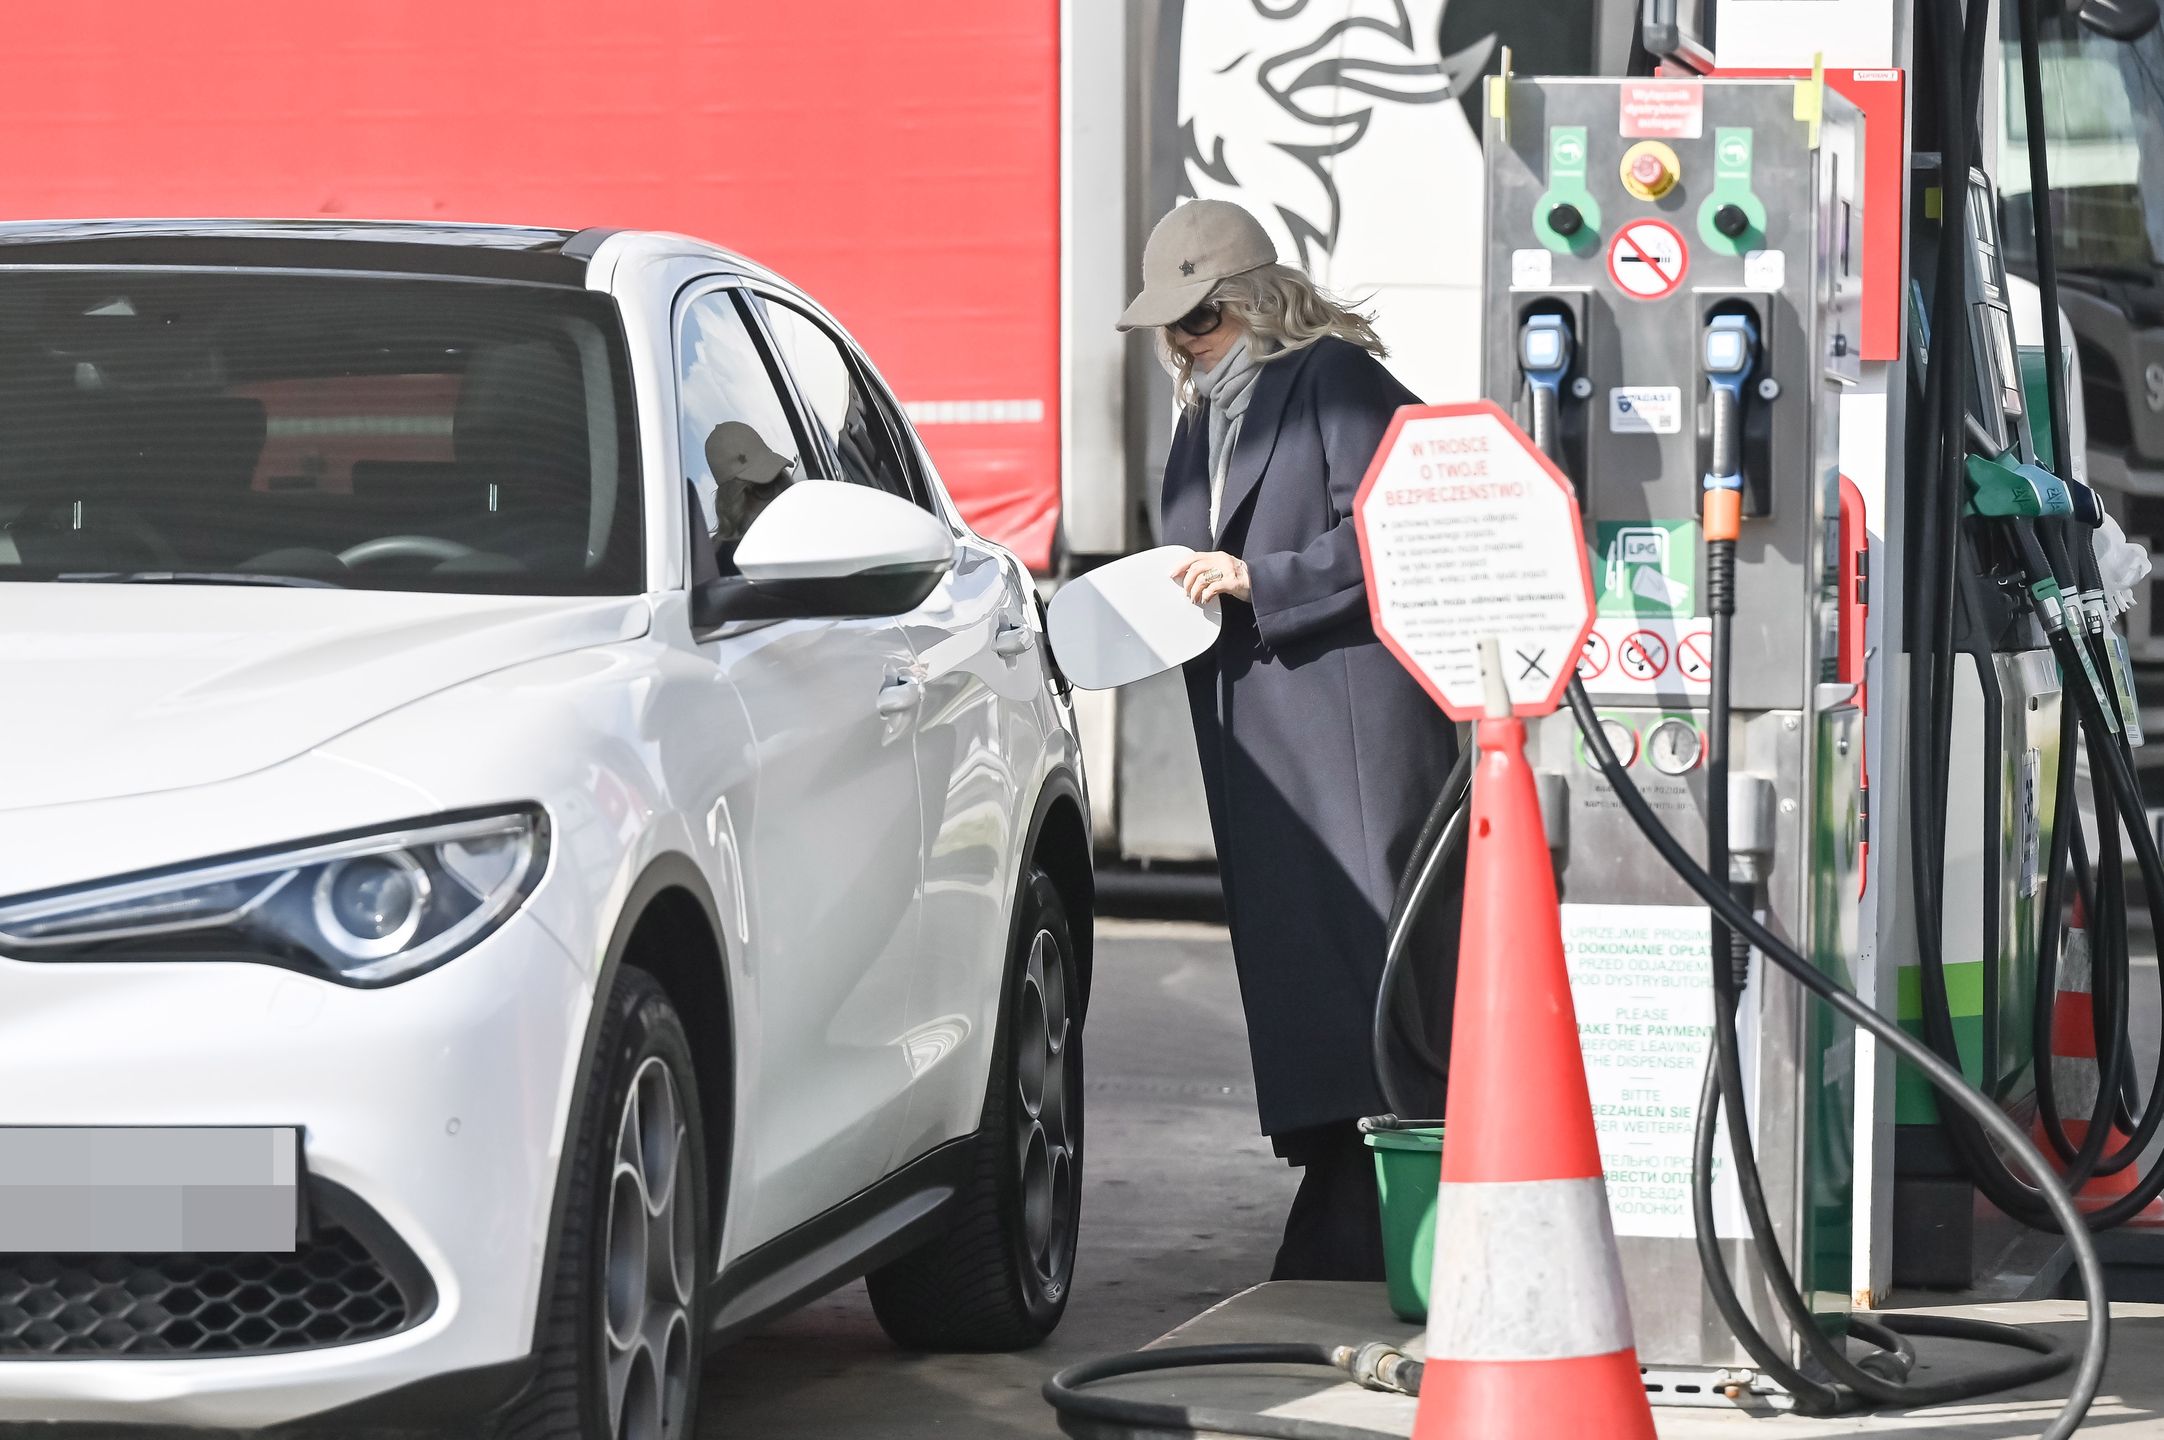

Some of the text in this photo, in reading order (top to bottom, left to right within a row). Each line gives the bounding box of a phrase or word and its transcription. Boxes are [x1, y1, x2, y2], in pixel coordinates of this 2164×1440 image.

[1410, 435, 1490, 457] W TROSCE
[1420, 459, 1489, 480] O TWOJE
[1628, 542, 1657, 555] LPG
[1569, 927, 1649, 939] UPRZEJMIE
[1578, 942, 1665, 955] DOKONANIE
[1578, 957, 1623, 970] PRZED
[1615, 1007, 1669, 1021] PLEASE
[1616, 1023, 1644, 1036] THE
[1648, 1024, 1714, 1038] PAYMENT
[1582, 1038, 1702, 1053] BEFORE LEAVING
[1583, 1054, 1611, 1067] THE
[1621, 1088, 1662, 1102] BITTE
[1591, 1104, 1691, 1118] BEZAHLEN SIE
